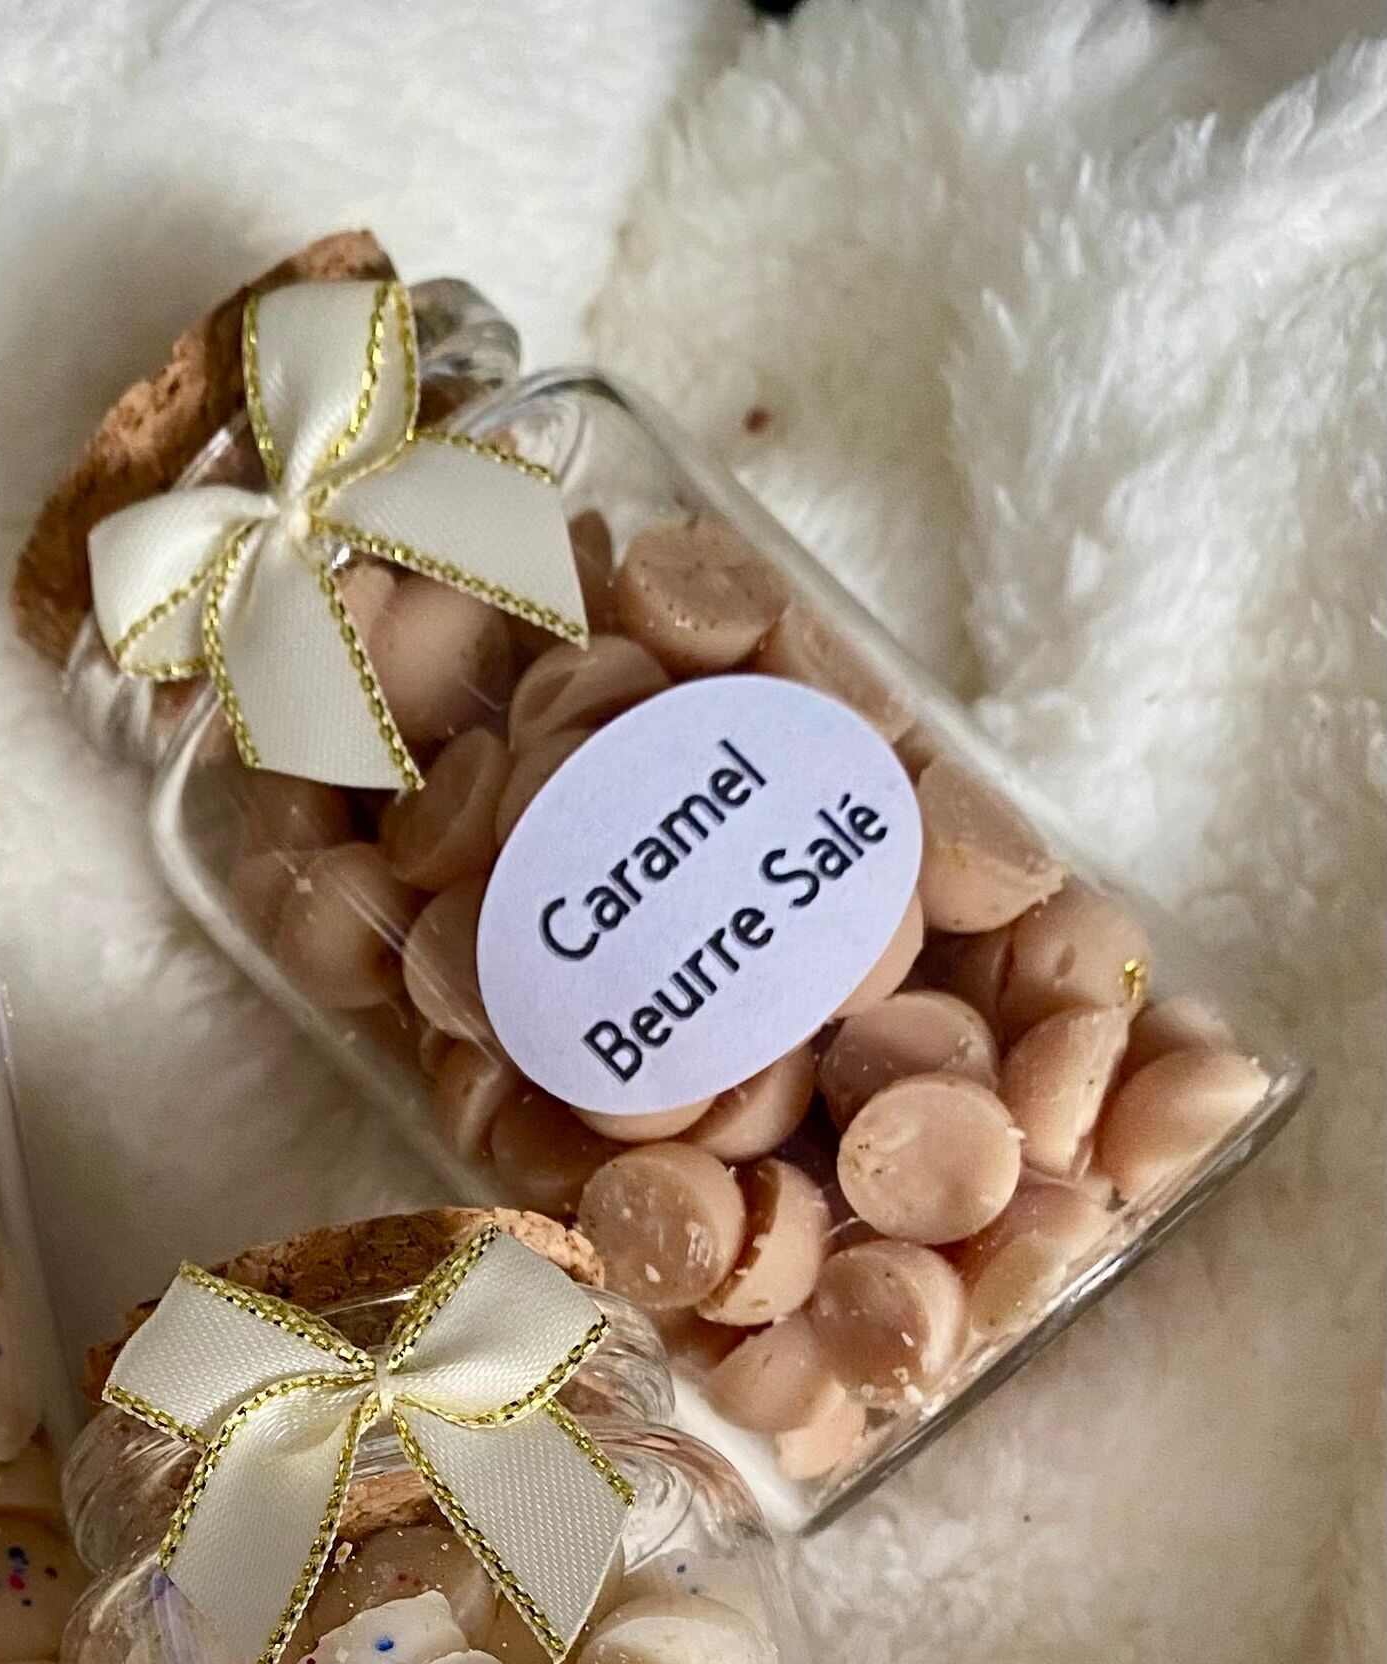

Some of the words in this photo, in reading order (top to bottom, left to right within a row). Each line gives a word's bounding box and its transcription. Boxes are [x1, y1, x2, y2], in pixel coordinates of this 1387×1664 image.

[540, 740, 766, 961] Caramel
[583, 906, 773, 1083] Beurre
[761, 794, 887, 908] Salé
